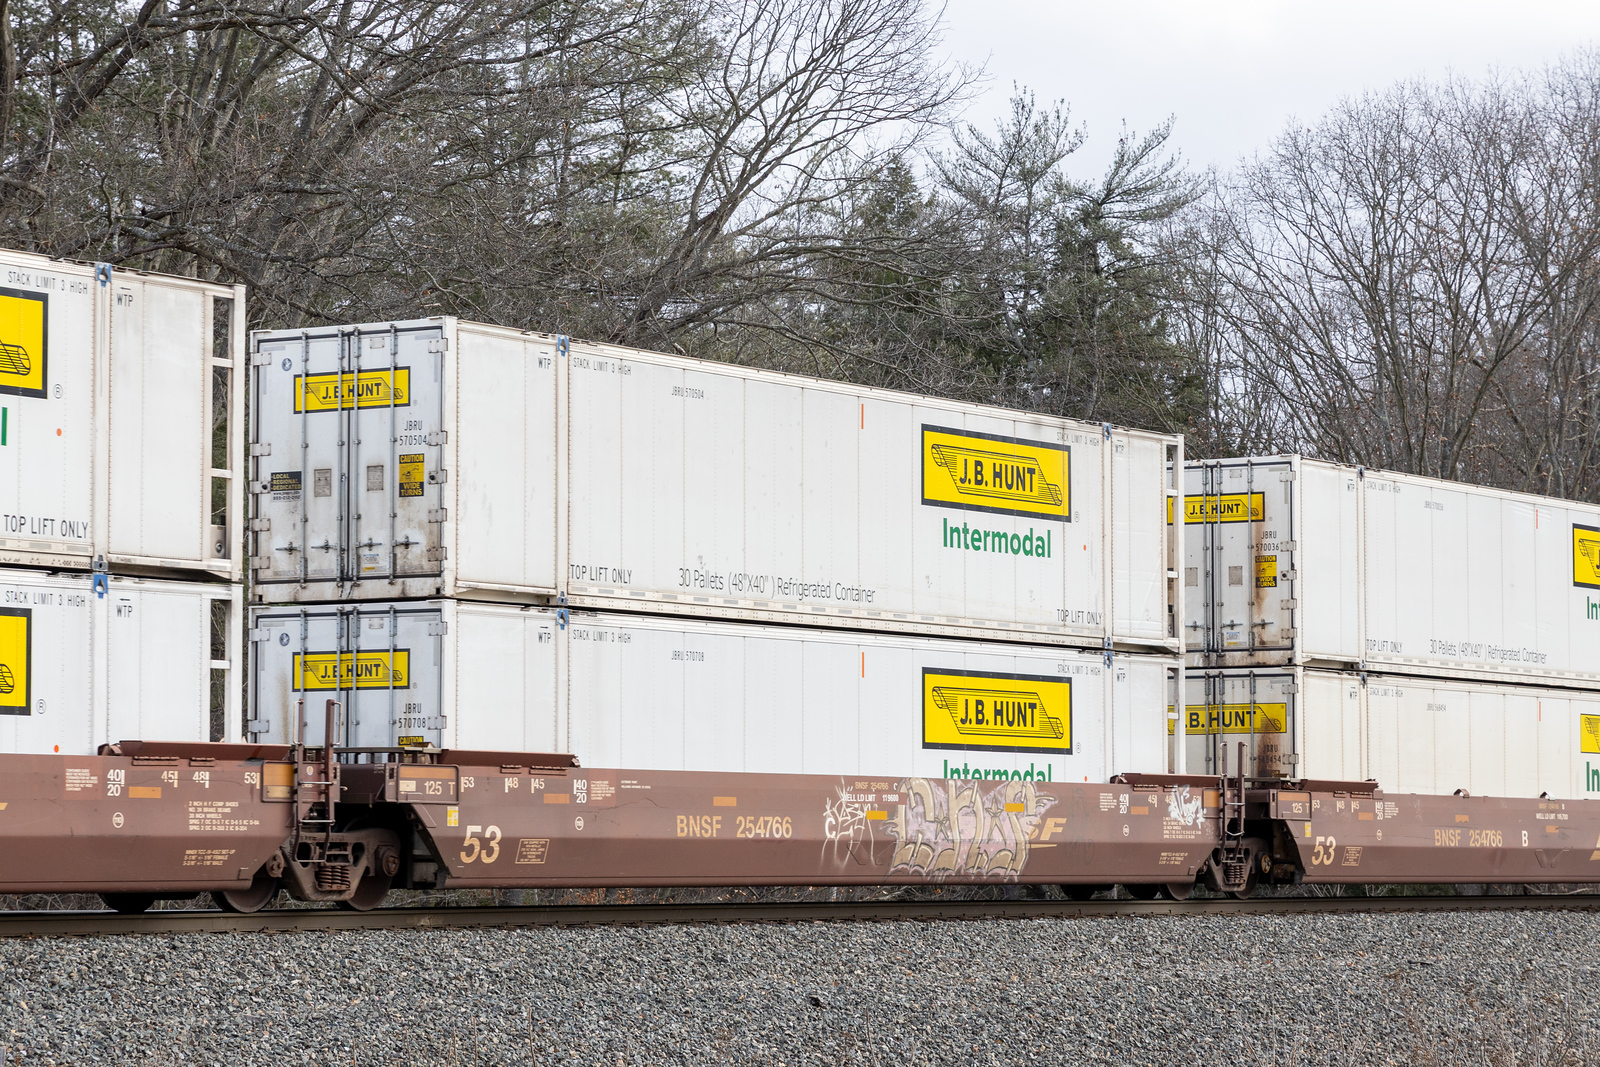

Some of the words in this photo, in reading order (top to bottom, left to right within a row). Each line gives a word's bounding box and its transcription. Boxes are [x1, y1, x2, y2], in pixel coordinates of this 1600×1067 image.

[8, 271, 31, 286] STACK
[36, 278, 56, 290] LIMIT
[61, 280, 66, 291] 3
[70, 281, 88, 295] HIGH
[117, 294, 134, 307] WTP
[538, 357, 552, 369] WTP
[573, 357, 590, 370] STACK
[593, 360, 608, 372] LIMIT
[612, 363, 616, 374] 3
[618, 363, 632, 376] HIGH
[685, 387, 704, 400] 570504
[404, 420, 423, 432] JBRU
[399, 435, 428, 446] 570504
[400, 454, 424, 463] CAUTION
[959, 458, 988, 487] J.B.
[993, 462, 1036, 493] HUNT
[4, 514, 26, 532] TOP
[31, 516, 55, 535] LIFT
[61, 520, 88, 539] ONLY
[943, 518, 1051, 558] Intermodal
[1261, 531, 1276, 540] JBRU
[1256, 543, 1280, 551] 570036
[570, 564, 587, 580] TOP
[590, 566, 608, 582] LIFT
[612, 568, 632, 584] ONLY
[679, 568, 690, 587] 30
[694, 570, 724, 590] Pallets
[778, 577, 831, 600] Refrigerated
[835, 582, 876, 602] Container
[5, 590, 28, 604] STACK
[33, 592, 53, 605] LIMIT
[58, 594, 62, 606] 3
[67, 595, 86, 608] HIGH
[116, 605, 133, 618] WTP
[1057, 608, 1070, 622] TOP
[1071, 610, 1084, 624] LIFT
[1087, 612, 1102, 624] ONLY
[538, 632, 552, 644] WTP
[573, 630, 590, 640] STACK
[593, 630, 608, 642] LIMIT
[612, 632, 615, 642] 3
[618, 632, 632, 644] HIGH
[1430, 639, 1437, 654] 30
[1439, 640, 1456, 656] Pallets
[1488, 644, 1520, 663] Refrigerated
[1522, 648, 1547, 664] Container
[1116, 672, 1126, 682] WTP
[403, 703, 422, 714] JBRU
[960, 698, 989, 726] J.B.
[994, 700, 1037, 728] HUNT
[398, 718, 427, 728] 570708
[1210, 710, 1256, 728] HUNT
[107, 769, 121, 781] 40
[161, 771, 174, 783] 45
[944, 760, 1052, 782] Intermodal
[192, 772, 205, 784] 48
[244, 772, 257, 785] 53
[464, 777, 474, 788] 53
[508, 778, 518, 788] 48
[534, 778, 544, 790] 45
[576, 779, 587, 790] 40
[107, 784, 121, 796] 20
[424, 780, 442, 795] 125
[448, 782, 456, 796] T
[576, 792, 587, 803] 20
[1120, 806, 1127, 814] 20
[1292, 803, 1302, 813] 125
[677, 815, 722, 838] BNSF
[736, 816, 792, 838] 254766
[460, 825, 502, 864] 53
[1434, 829, 1461, 846] BNSF
[1469, 830, 1502, 847] 254766
[1522, 830, 1528, 847] B
[1312, 836, 1336, 866] 53
